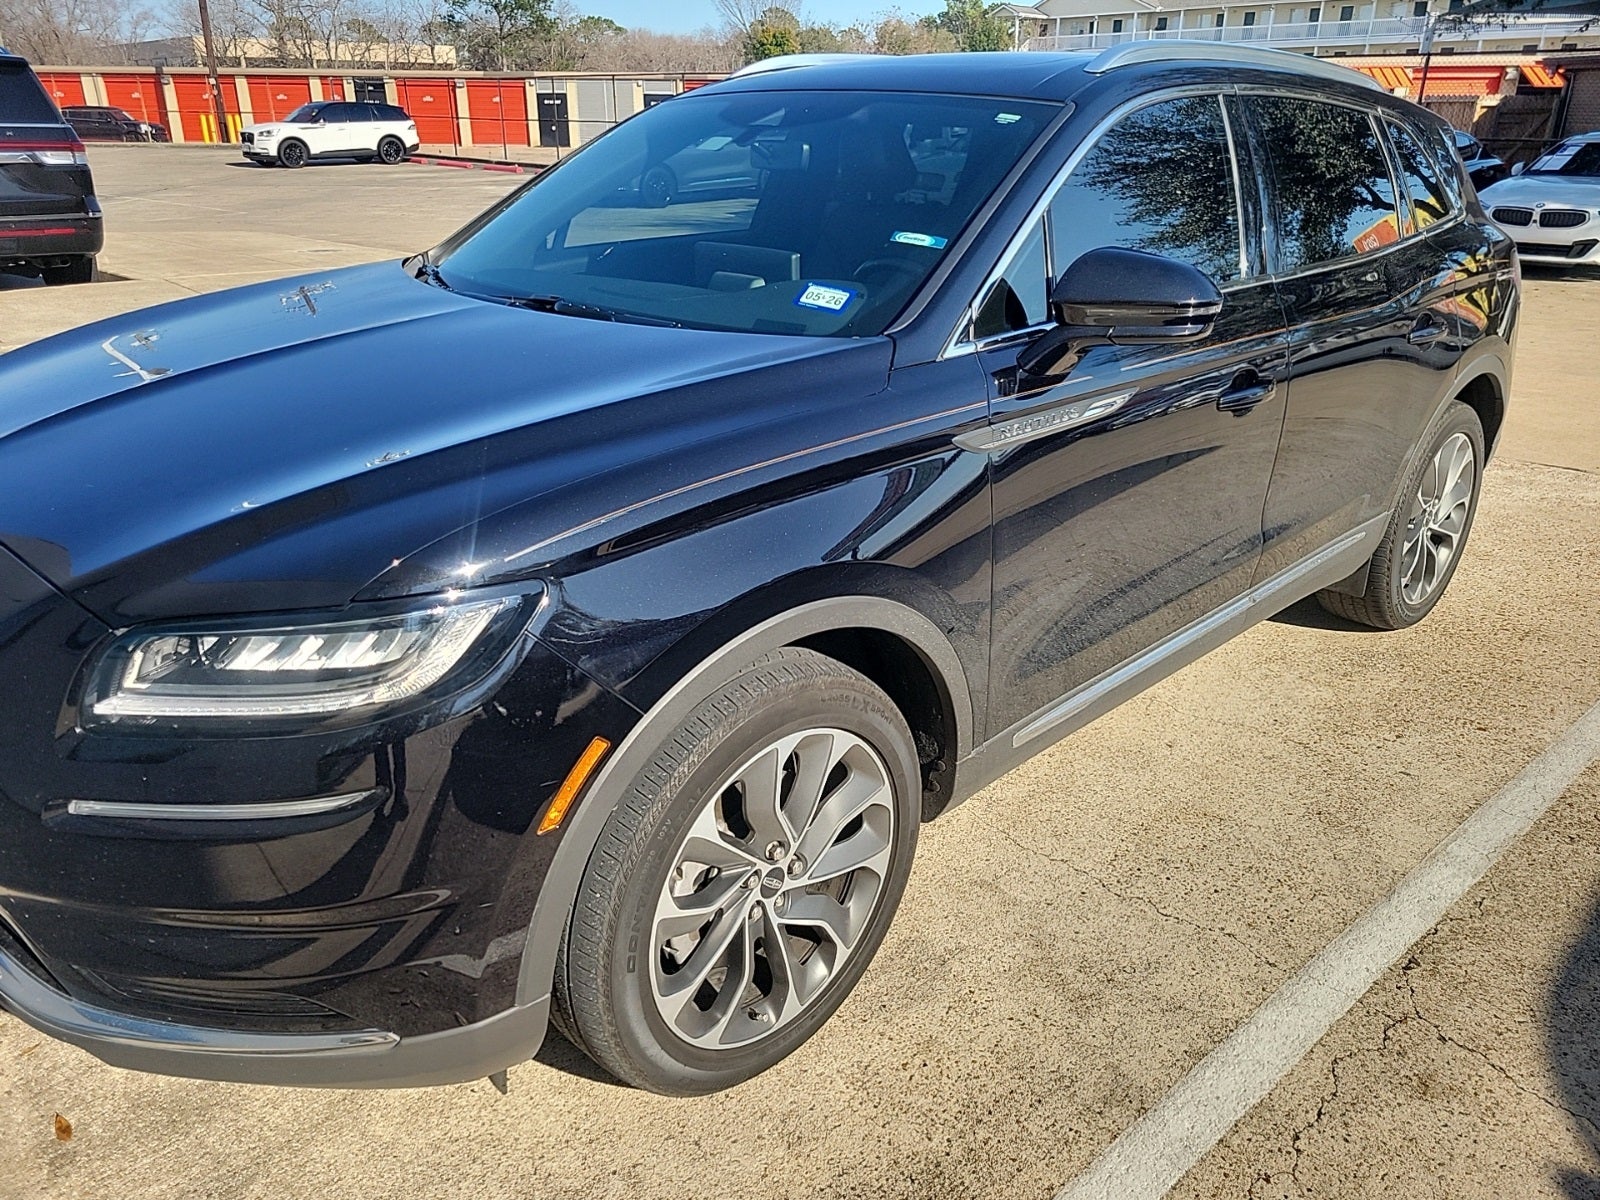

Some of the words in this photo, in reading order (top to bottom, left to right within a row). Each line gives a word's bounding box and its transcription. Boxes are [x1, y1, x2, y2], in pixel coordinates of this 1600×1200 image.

[806, 291, 822, 301] 05
[825, 295, 844, 305] 26
[1000, 407, 1079, 439] NAUTILUS
